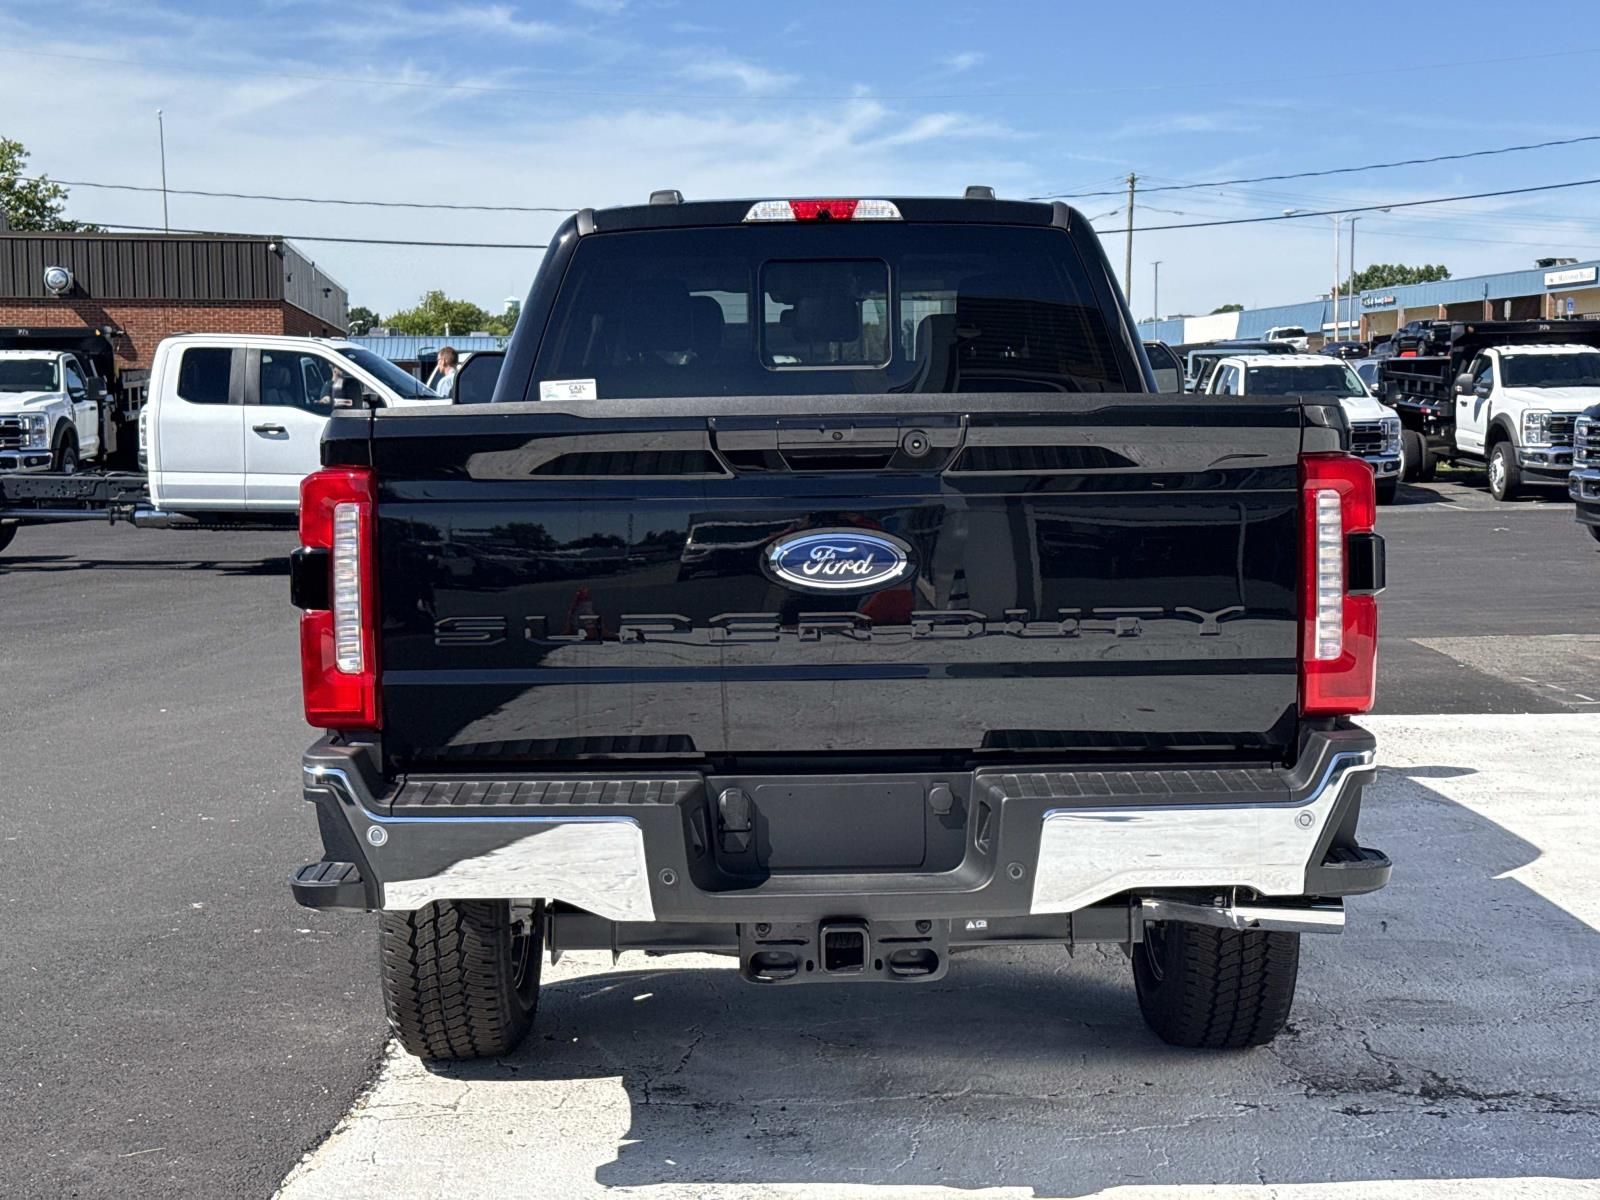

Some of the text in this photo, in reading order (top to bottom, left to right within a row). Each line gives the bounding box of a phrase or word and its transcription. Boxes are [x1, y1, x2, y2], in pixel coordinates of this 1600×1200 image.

[803, 545, 873, 575] Ford
[434, 605, 1246, 646] SUPER DUTY
